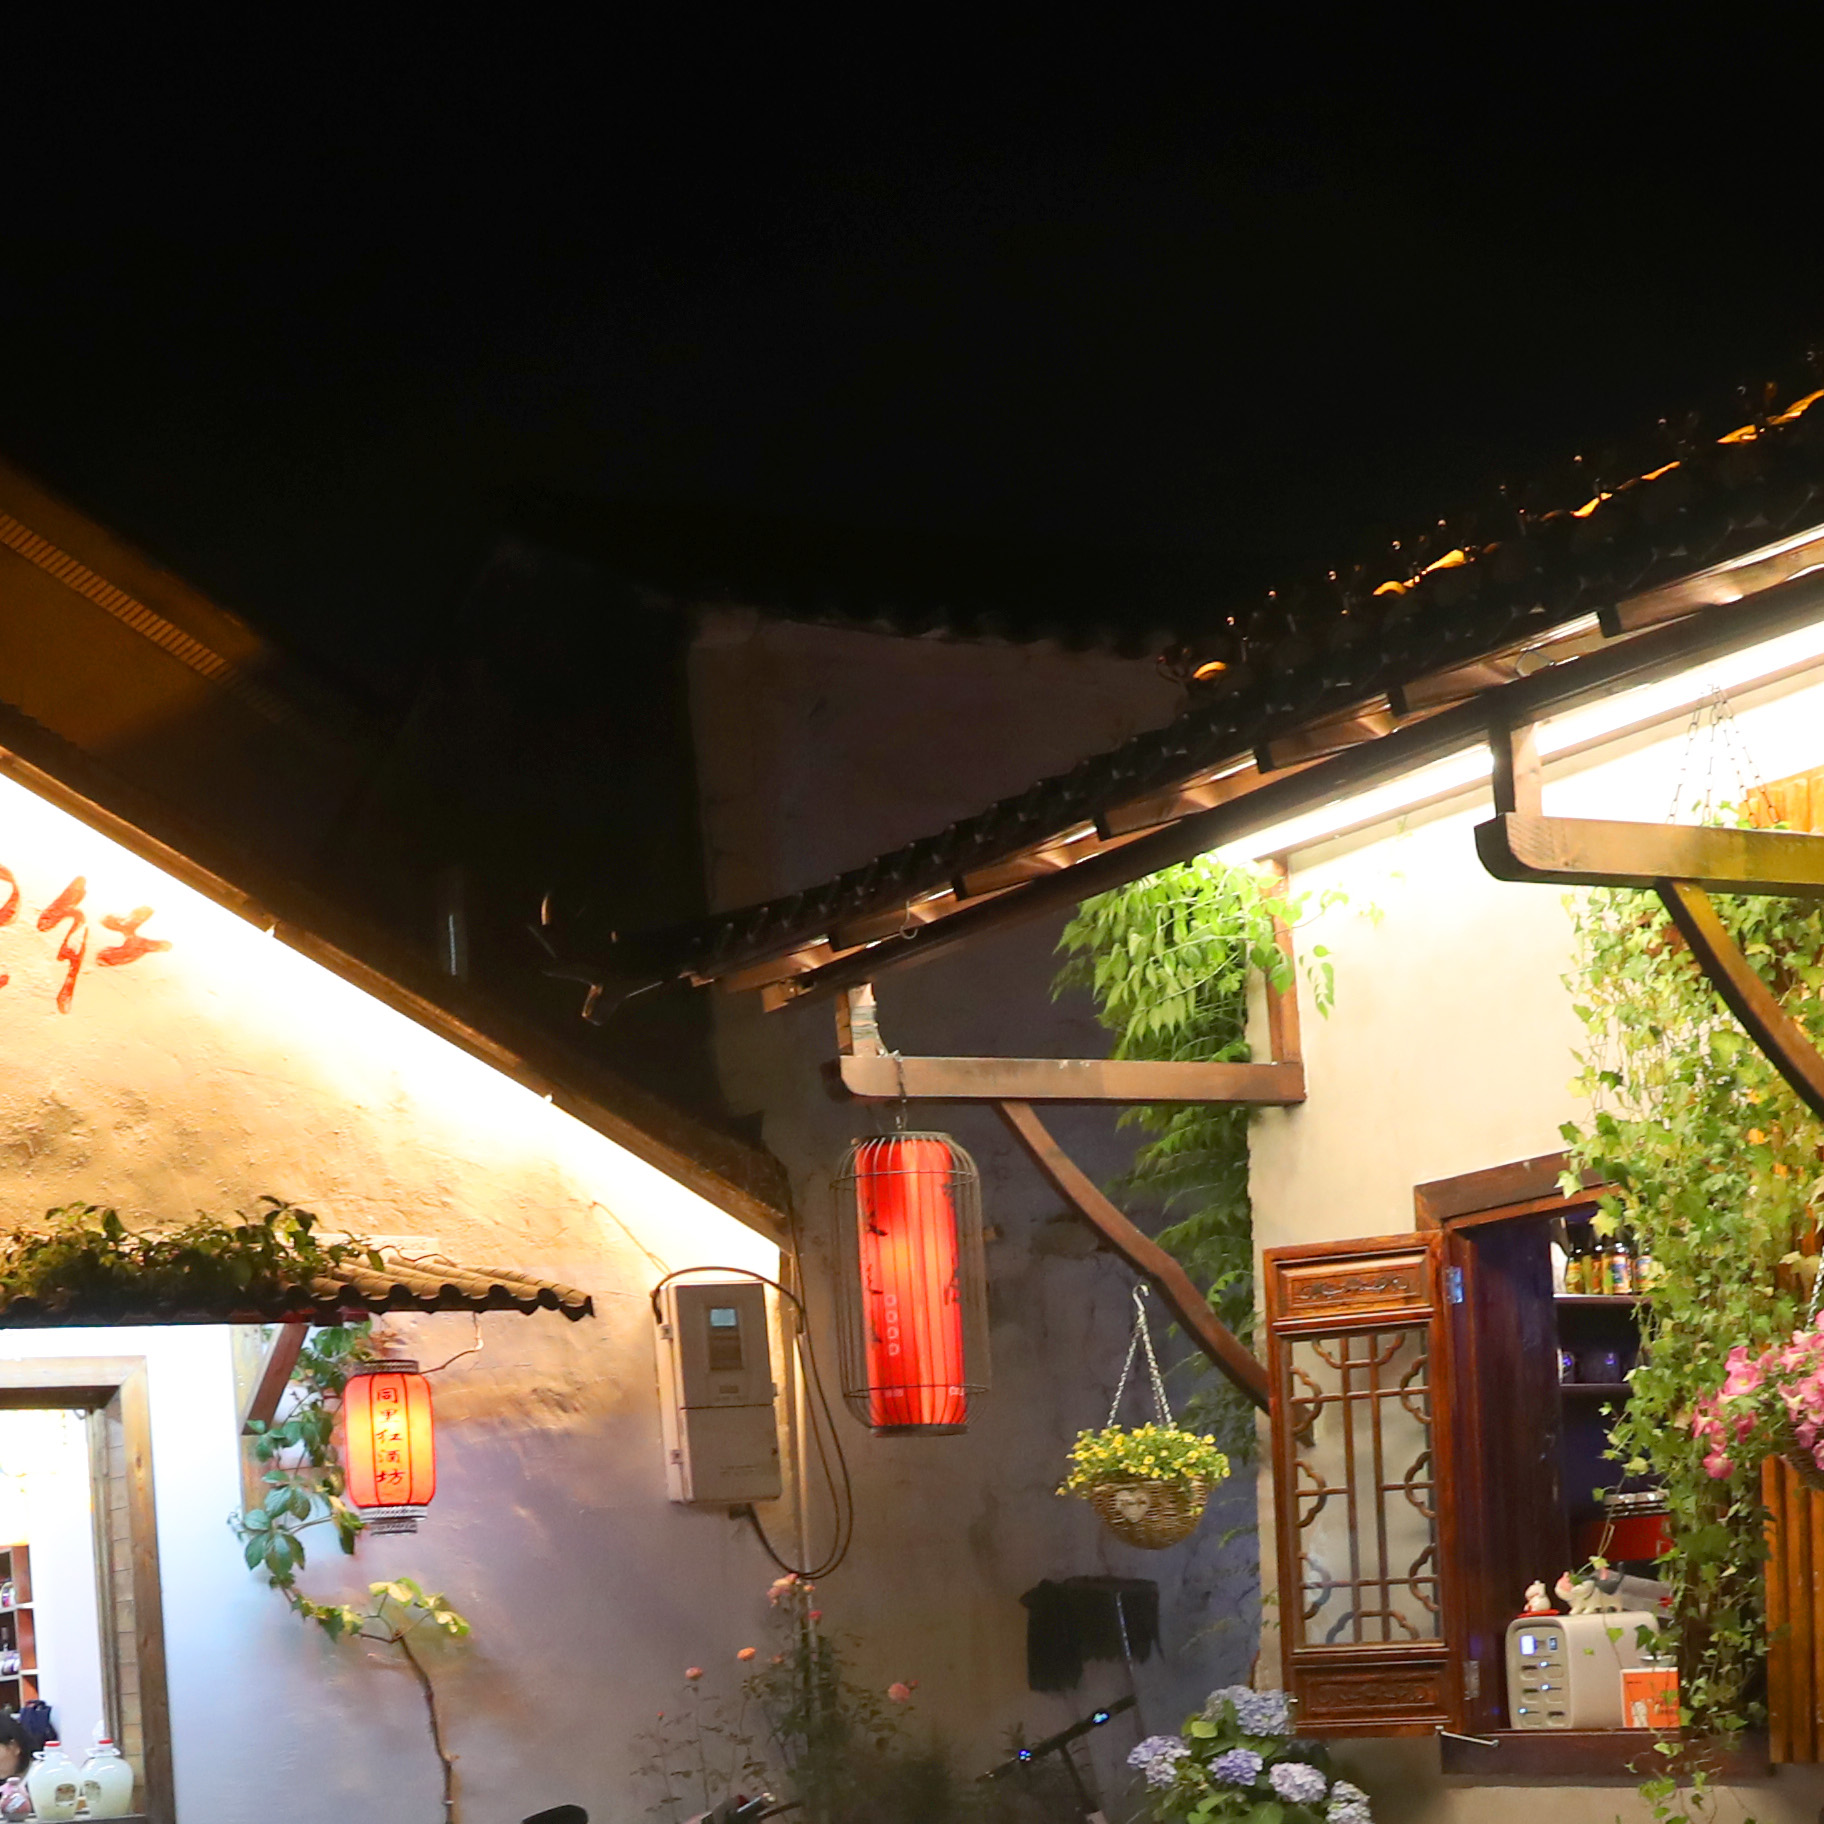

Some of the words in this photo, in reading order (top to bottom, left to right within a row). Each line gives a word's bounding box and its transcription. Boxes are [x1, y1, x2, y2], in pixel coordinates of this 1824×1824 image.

[374, 1387, 407, 1486] 同里红酒坊
